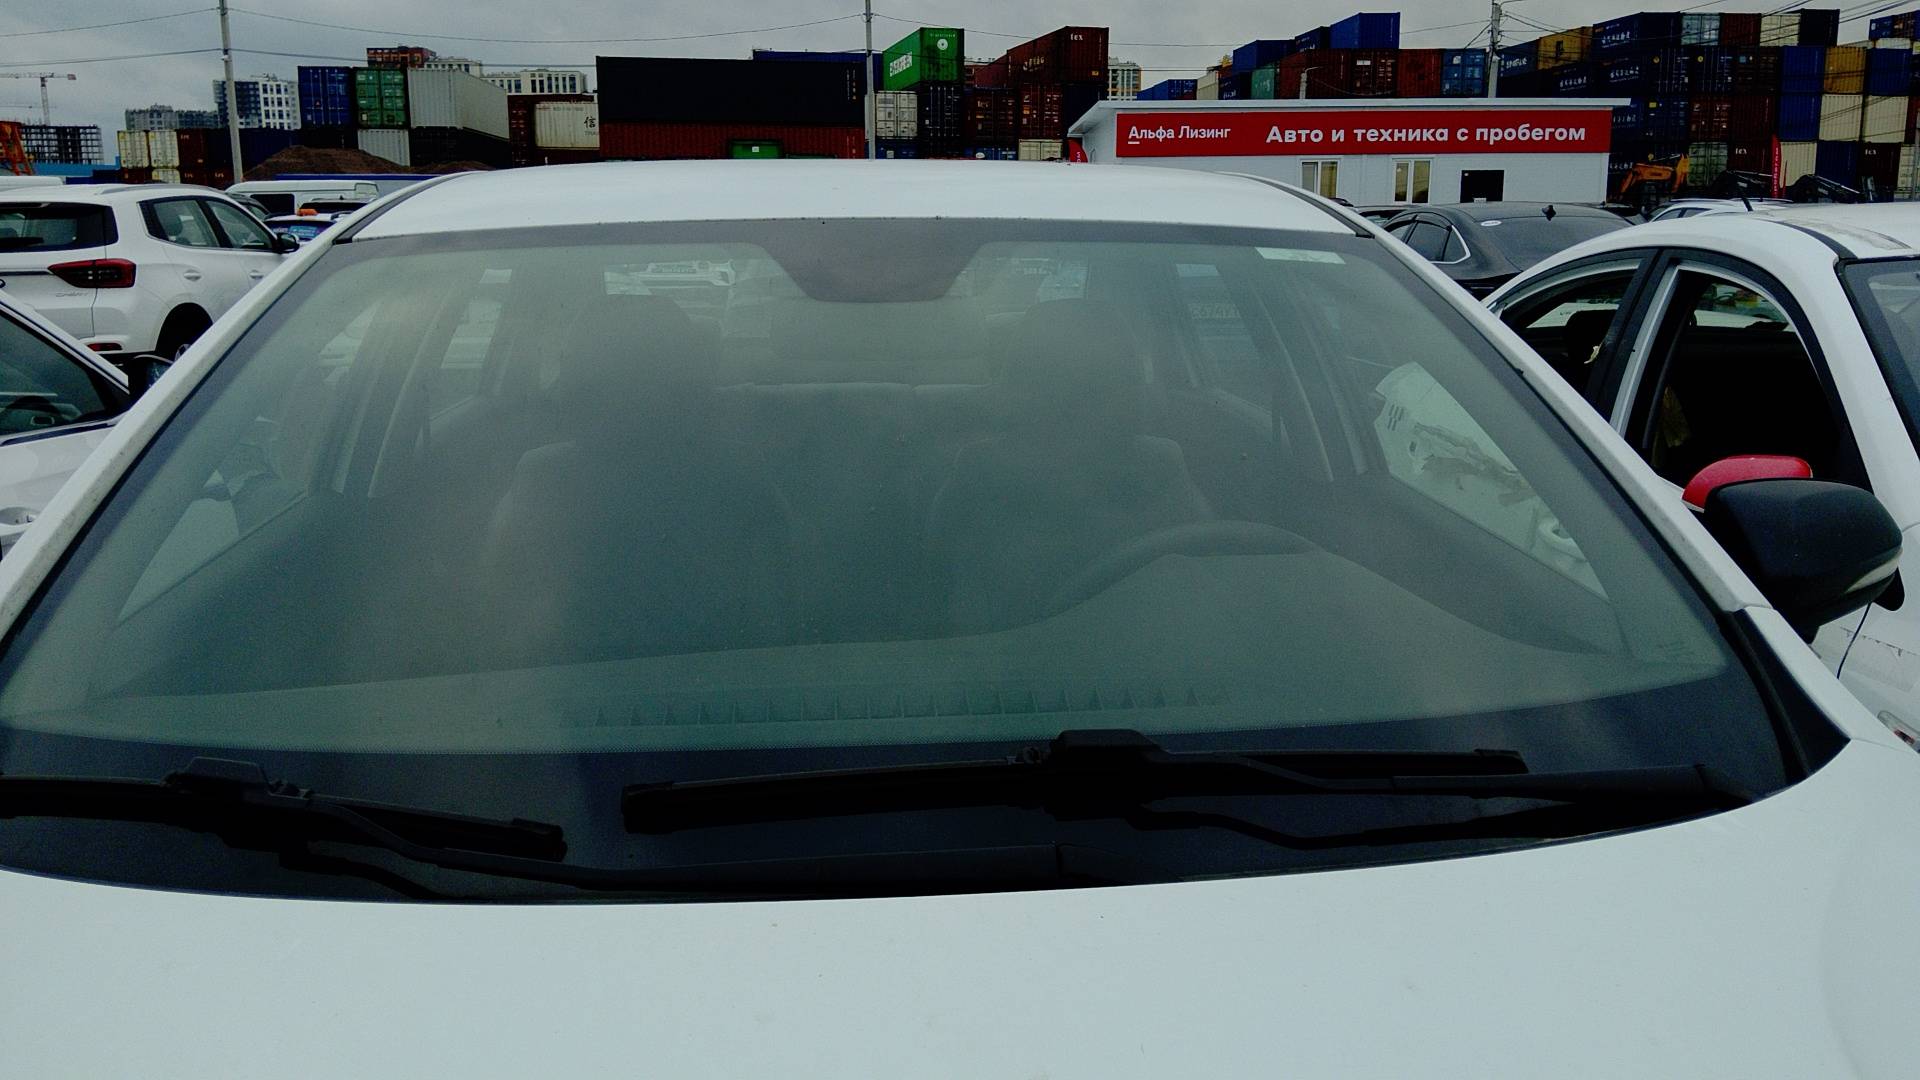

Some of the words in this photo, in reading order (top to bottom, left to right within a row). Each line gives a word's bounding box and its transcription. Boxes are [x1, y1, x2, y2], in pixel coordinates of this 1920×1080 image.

[1128, 125, 1175, 142] Альфа
[1178, 125, 1231, 140] Лизинг
[1265, 125, 1324, 143] Авто
[1331, 129, 1345, 143] и
[1353, 128, 1449, 142] техника
[1456, 128, 1469, 141] с
[1475, 124, 1586, 145] пробегом
